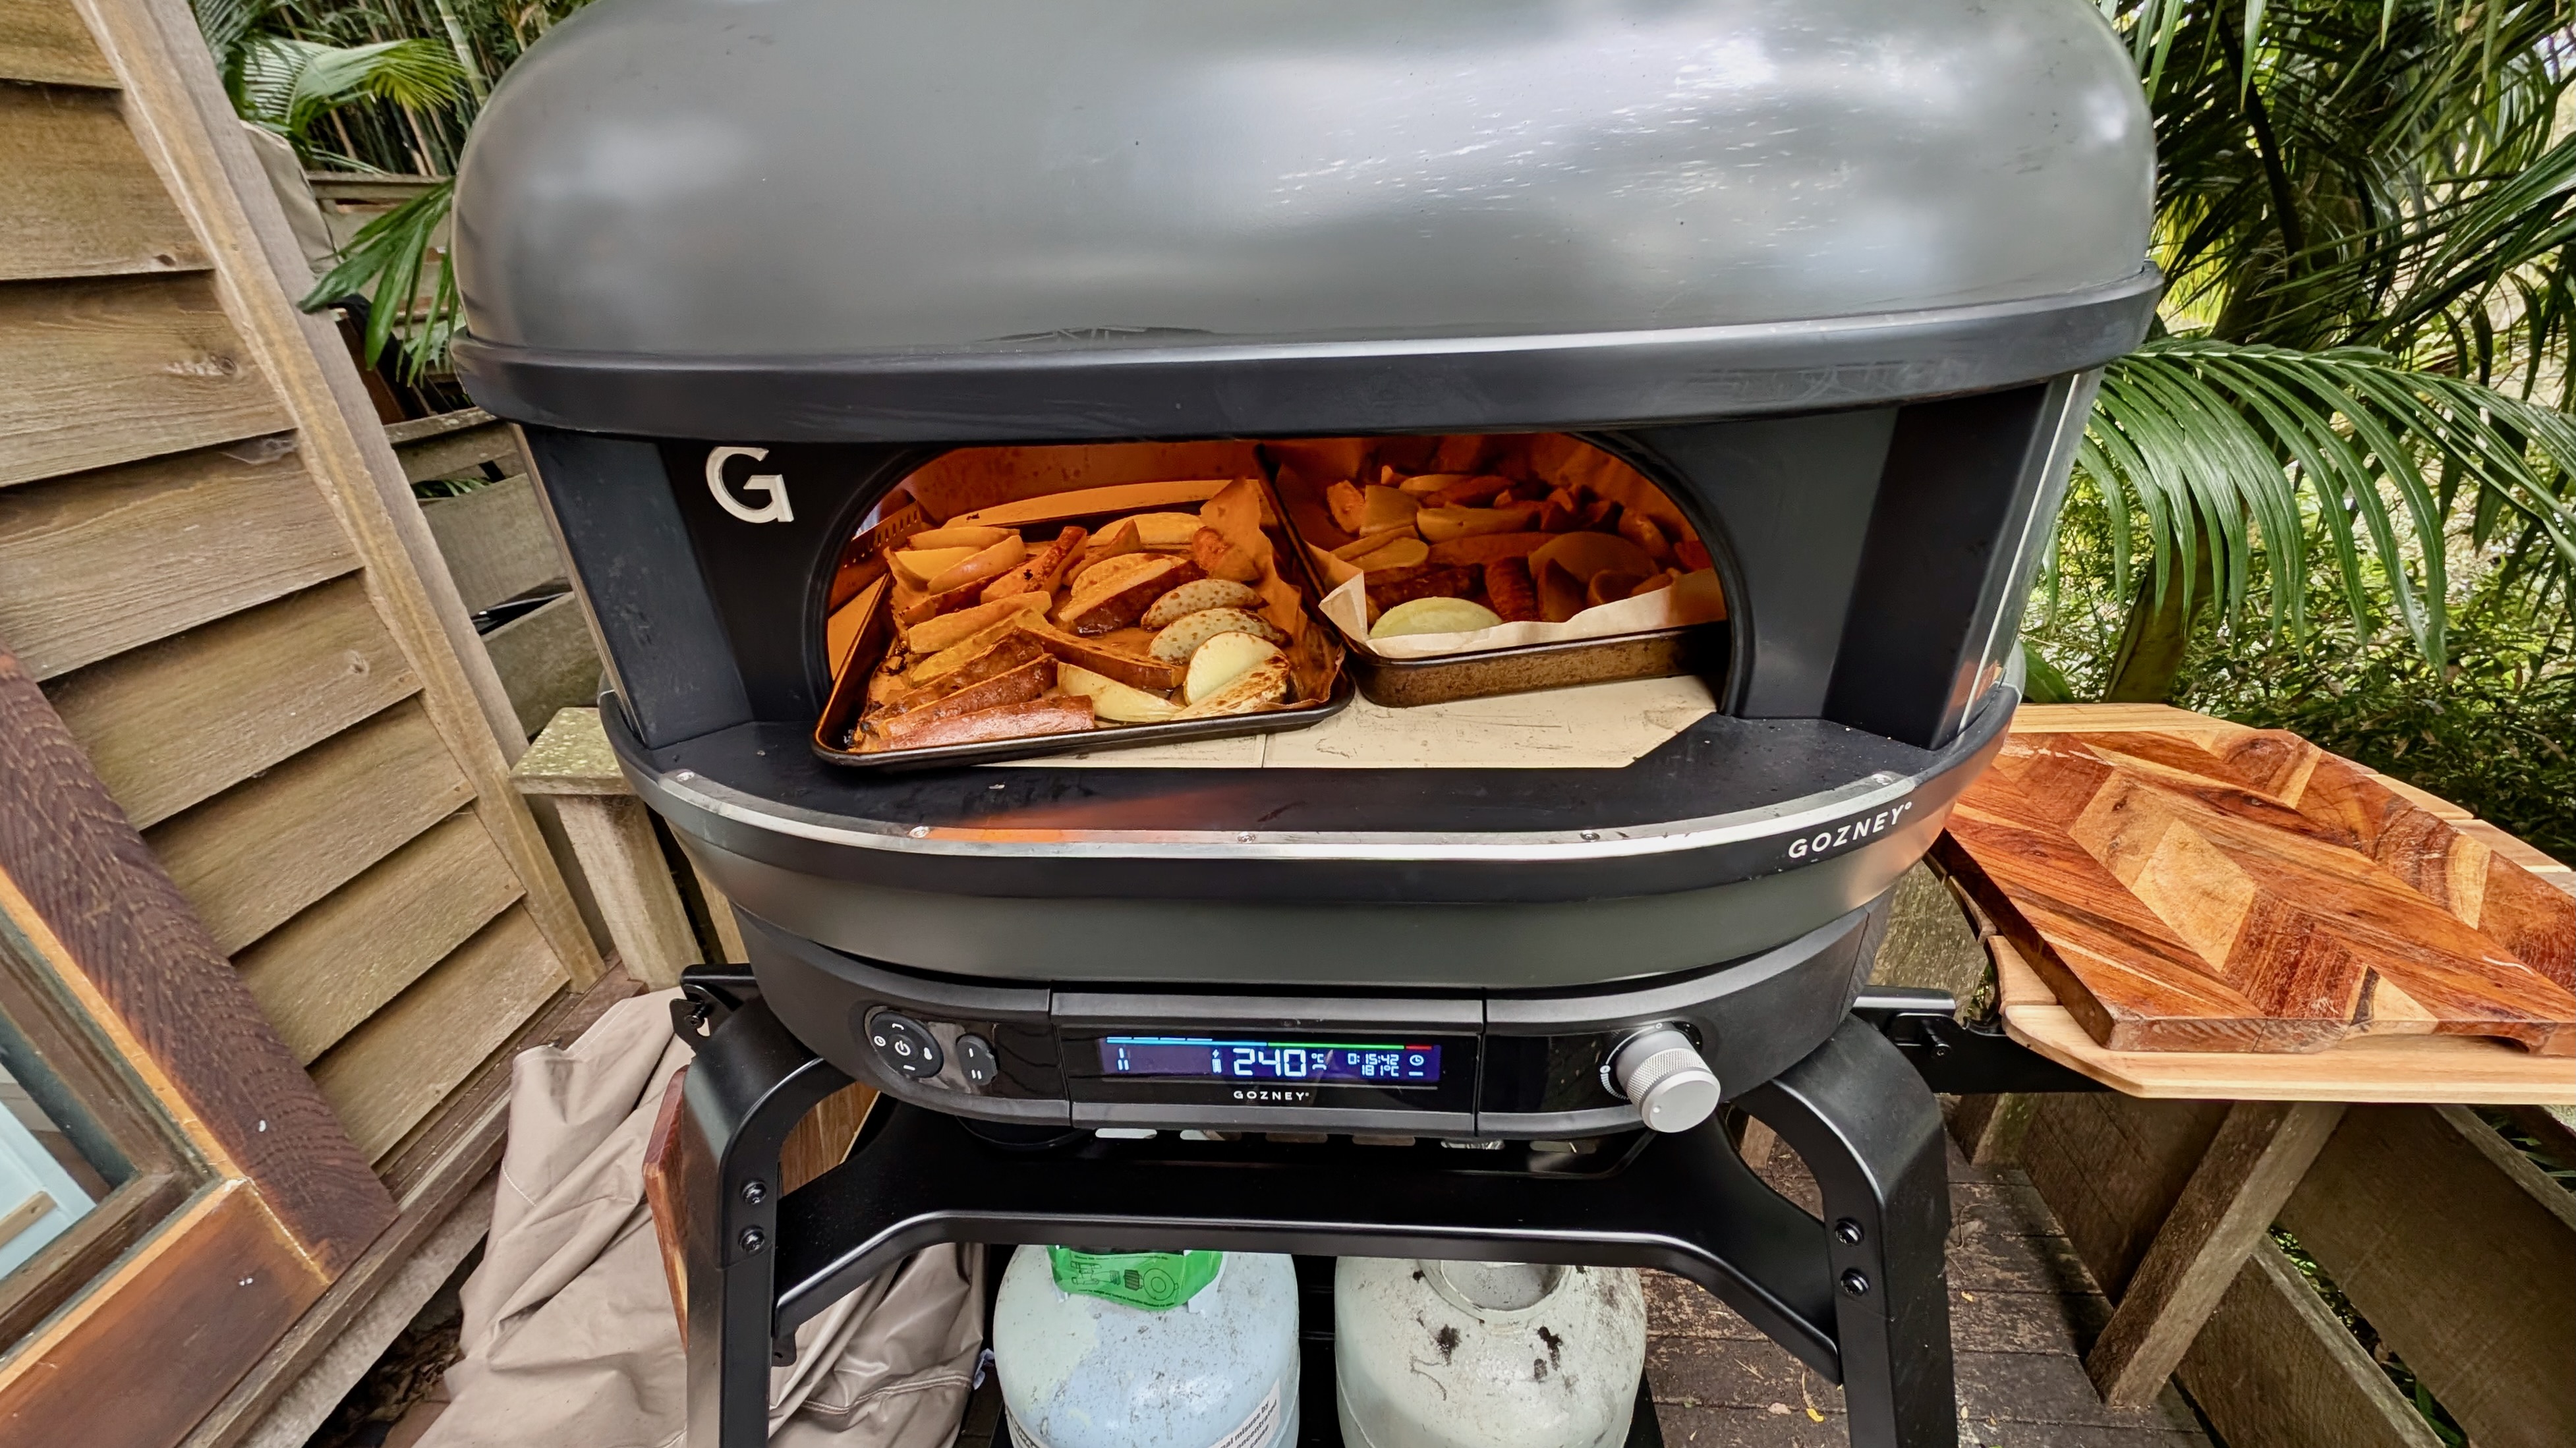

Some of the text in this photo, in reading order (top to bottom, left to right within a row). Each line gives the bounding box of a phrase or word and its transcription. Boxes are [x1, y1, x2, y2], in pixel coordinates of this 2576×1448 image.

[705, 446, 794, 523] G
[1235, 1412, 1261, 1441] misuse
[1261, 1401, 1269, 1414] by
